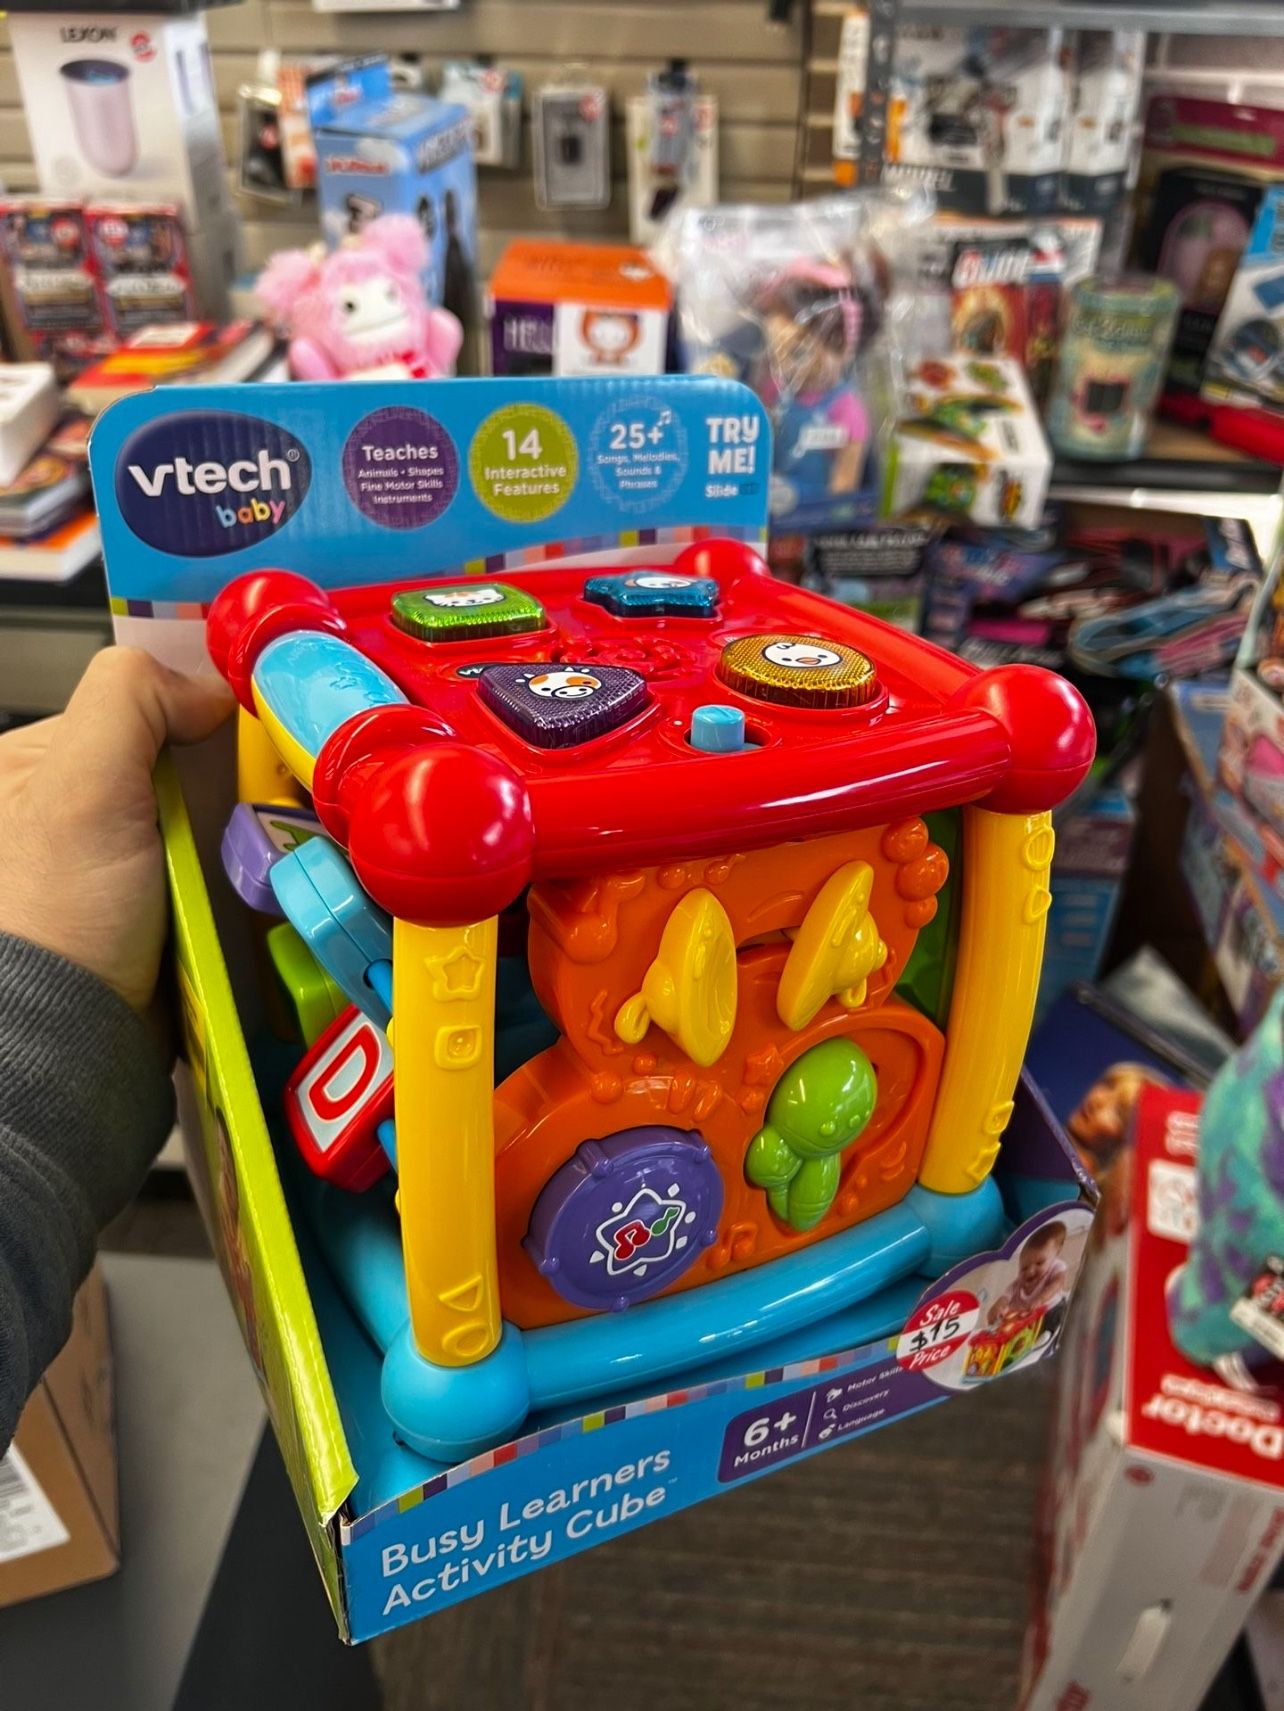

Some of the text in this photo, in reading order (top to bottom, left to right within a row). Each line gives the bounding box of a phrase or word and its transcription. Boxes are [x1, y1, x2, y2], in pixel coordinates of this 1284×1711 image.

[609, 423, 664, 450] 25+
[706, 414, 760, 444] TRY
[361, 443, 439, 461] Teaches
[502, 428, 544, 461] 14
[358, 465, 444, 479] Animals Shapes
[484, 464, 567, 480] Interactive
[615, 465, 652, 477] Sounds
[708, 446, 757, 475] ME!
[360, 479, 444, 492] Fine Motor Skills
[492, 482, 560, 497] Features
[705, 482, 739, 498] Slide
[373, 493, 433, 505] Instruments
[216, 498, 286, 529] baby
[307, 1022, 382, 1123] D
[920, 1299, 961, 1327] Sale
[910, 1315, 960, 1352] $15
[909, 1344, 951, 1370] Price
[847, 1375, 877, 1392] Motor
[842, 1388, 891, 1413] Discovery
[743, 1411, 798, 1448] 6+
[837, 1408, 886, 1431] Language
[734, 1432, 799, 1468] Months
[381, 1449, 672, 1578] Busy Learners
[382, 1486, 667, 1616] Activity Cube
